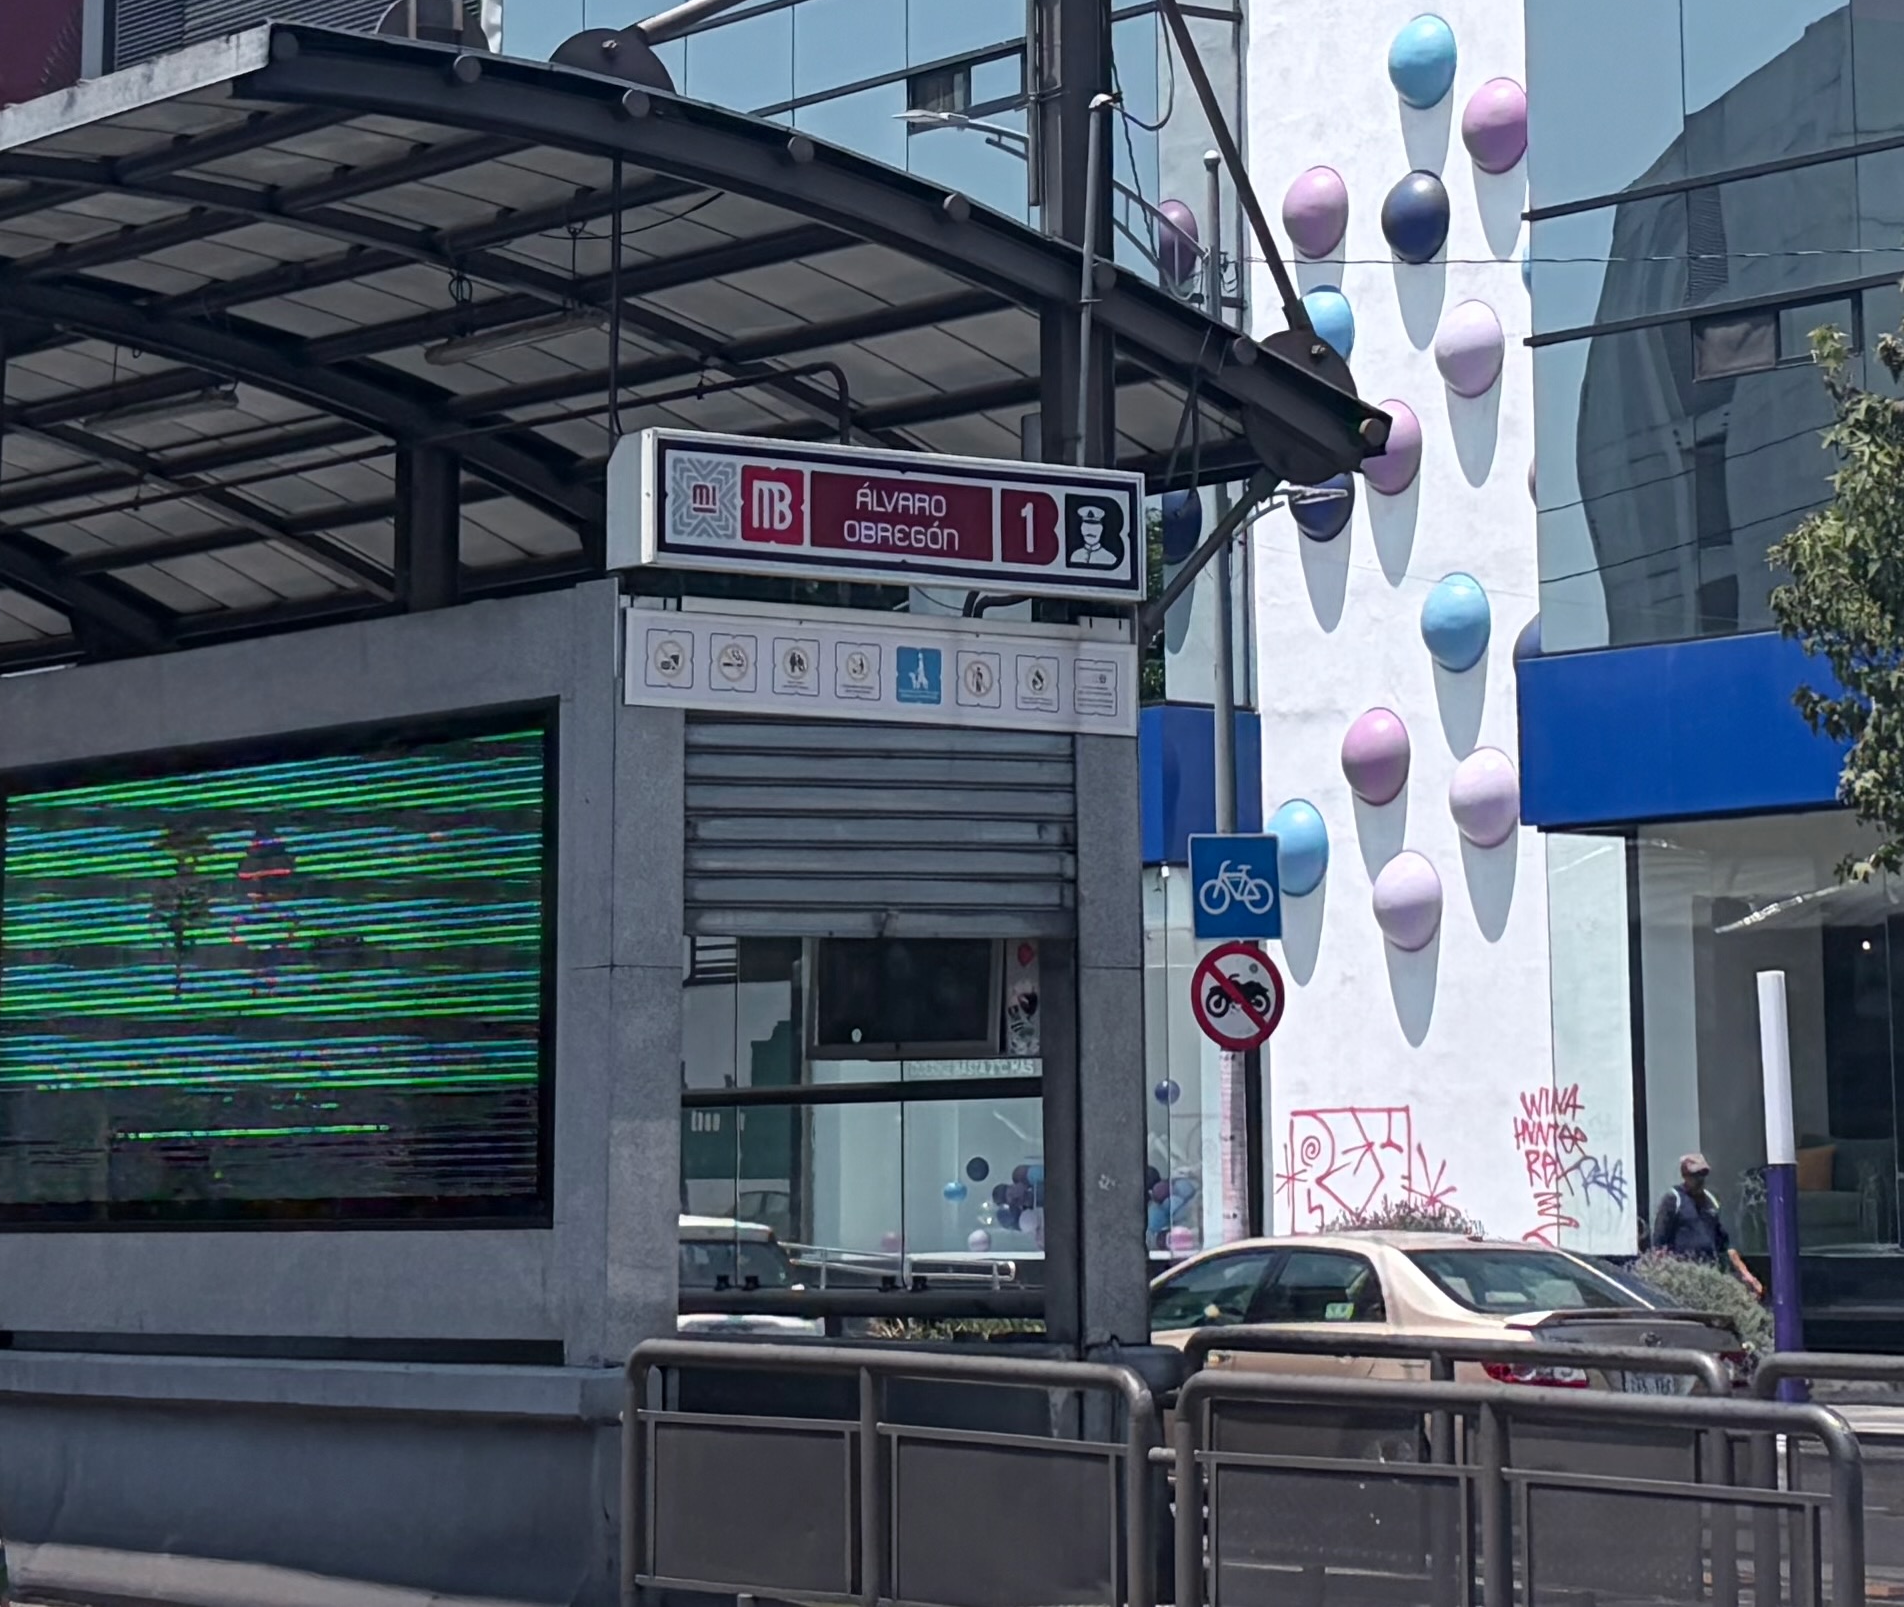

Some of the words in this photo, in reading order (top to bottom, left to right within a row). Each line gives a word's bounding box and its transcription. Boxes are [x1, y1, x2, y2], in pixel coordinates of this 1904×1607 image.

[751, 480, 793, 532] MB
[855, 481, 947, 518] ÁLVARO
[843, 520, 960, 552] OBREGÓN
[1020, 502, 1035, 554] 1
